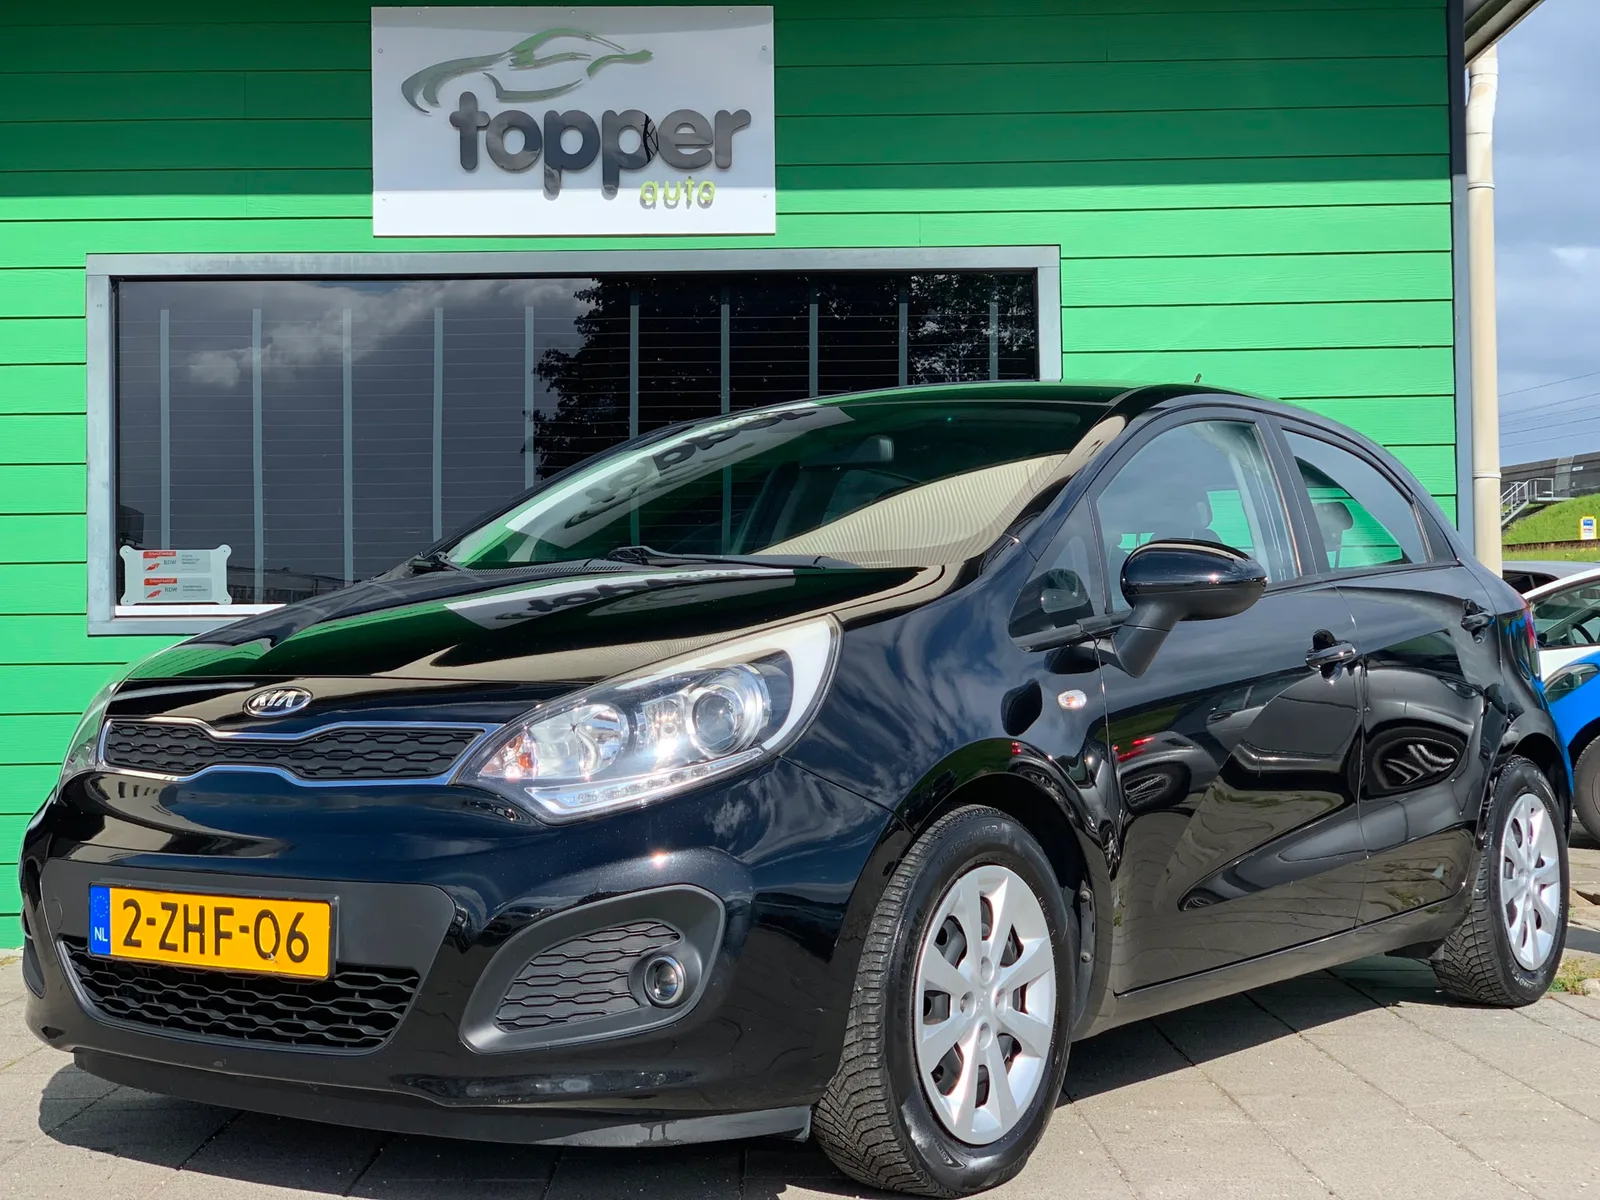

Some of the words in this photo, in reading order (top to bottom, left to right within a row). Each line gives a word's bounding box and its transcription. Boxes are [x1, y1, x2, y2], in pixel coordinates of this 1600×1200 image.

[449, 91, 752, 200] topper
[640, 176, 716, 201] auto
[94, 926, 108, 942] NL
[122, 897, 310, 964] 2-ZHF-06
